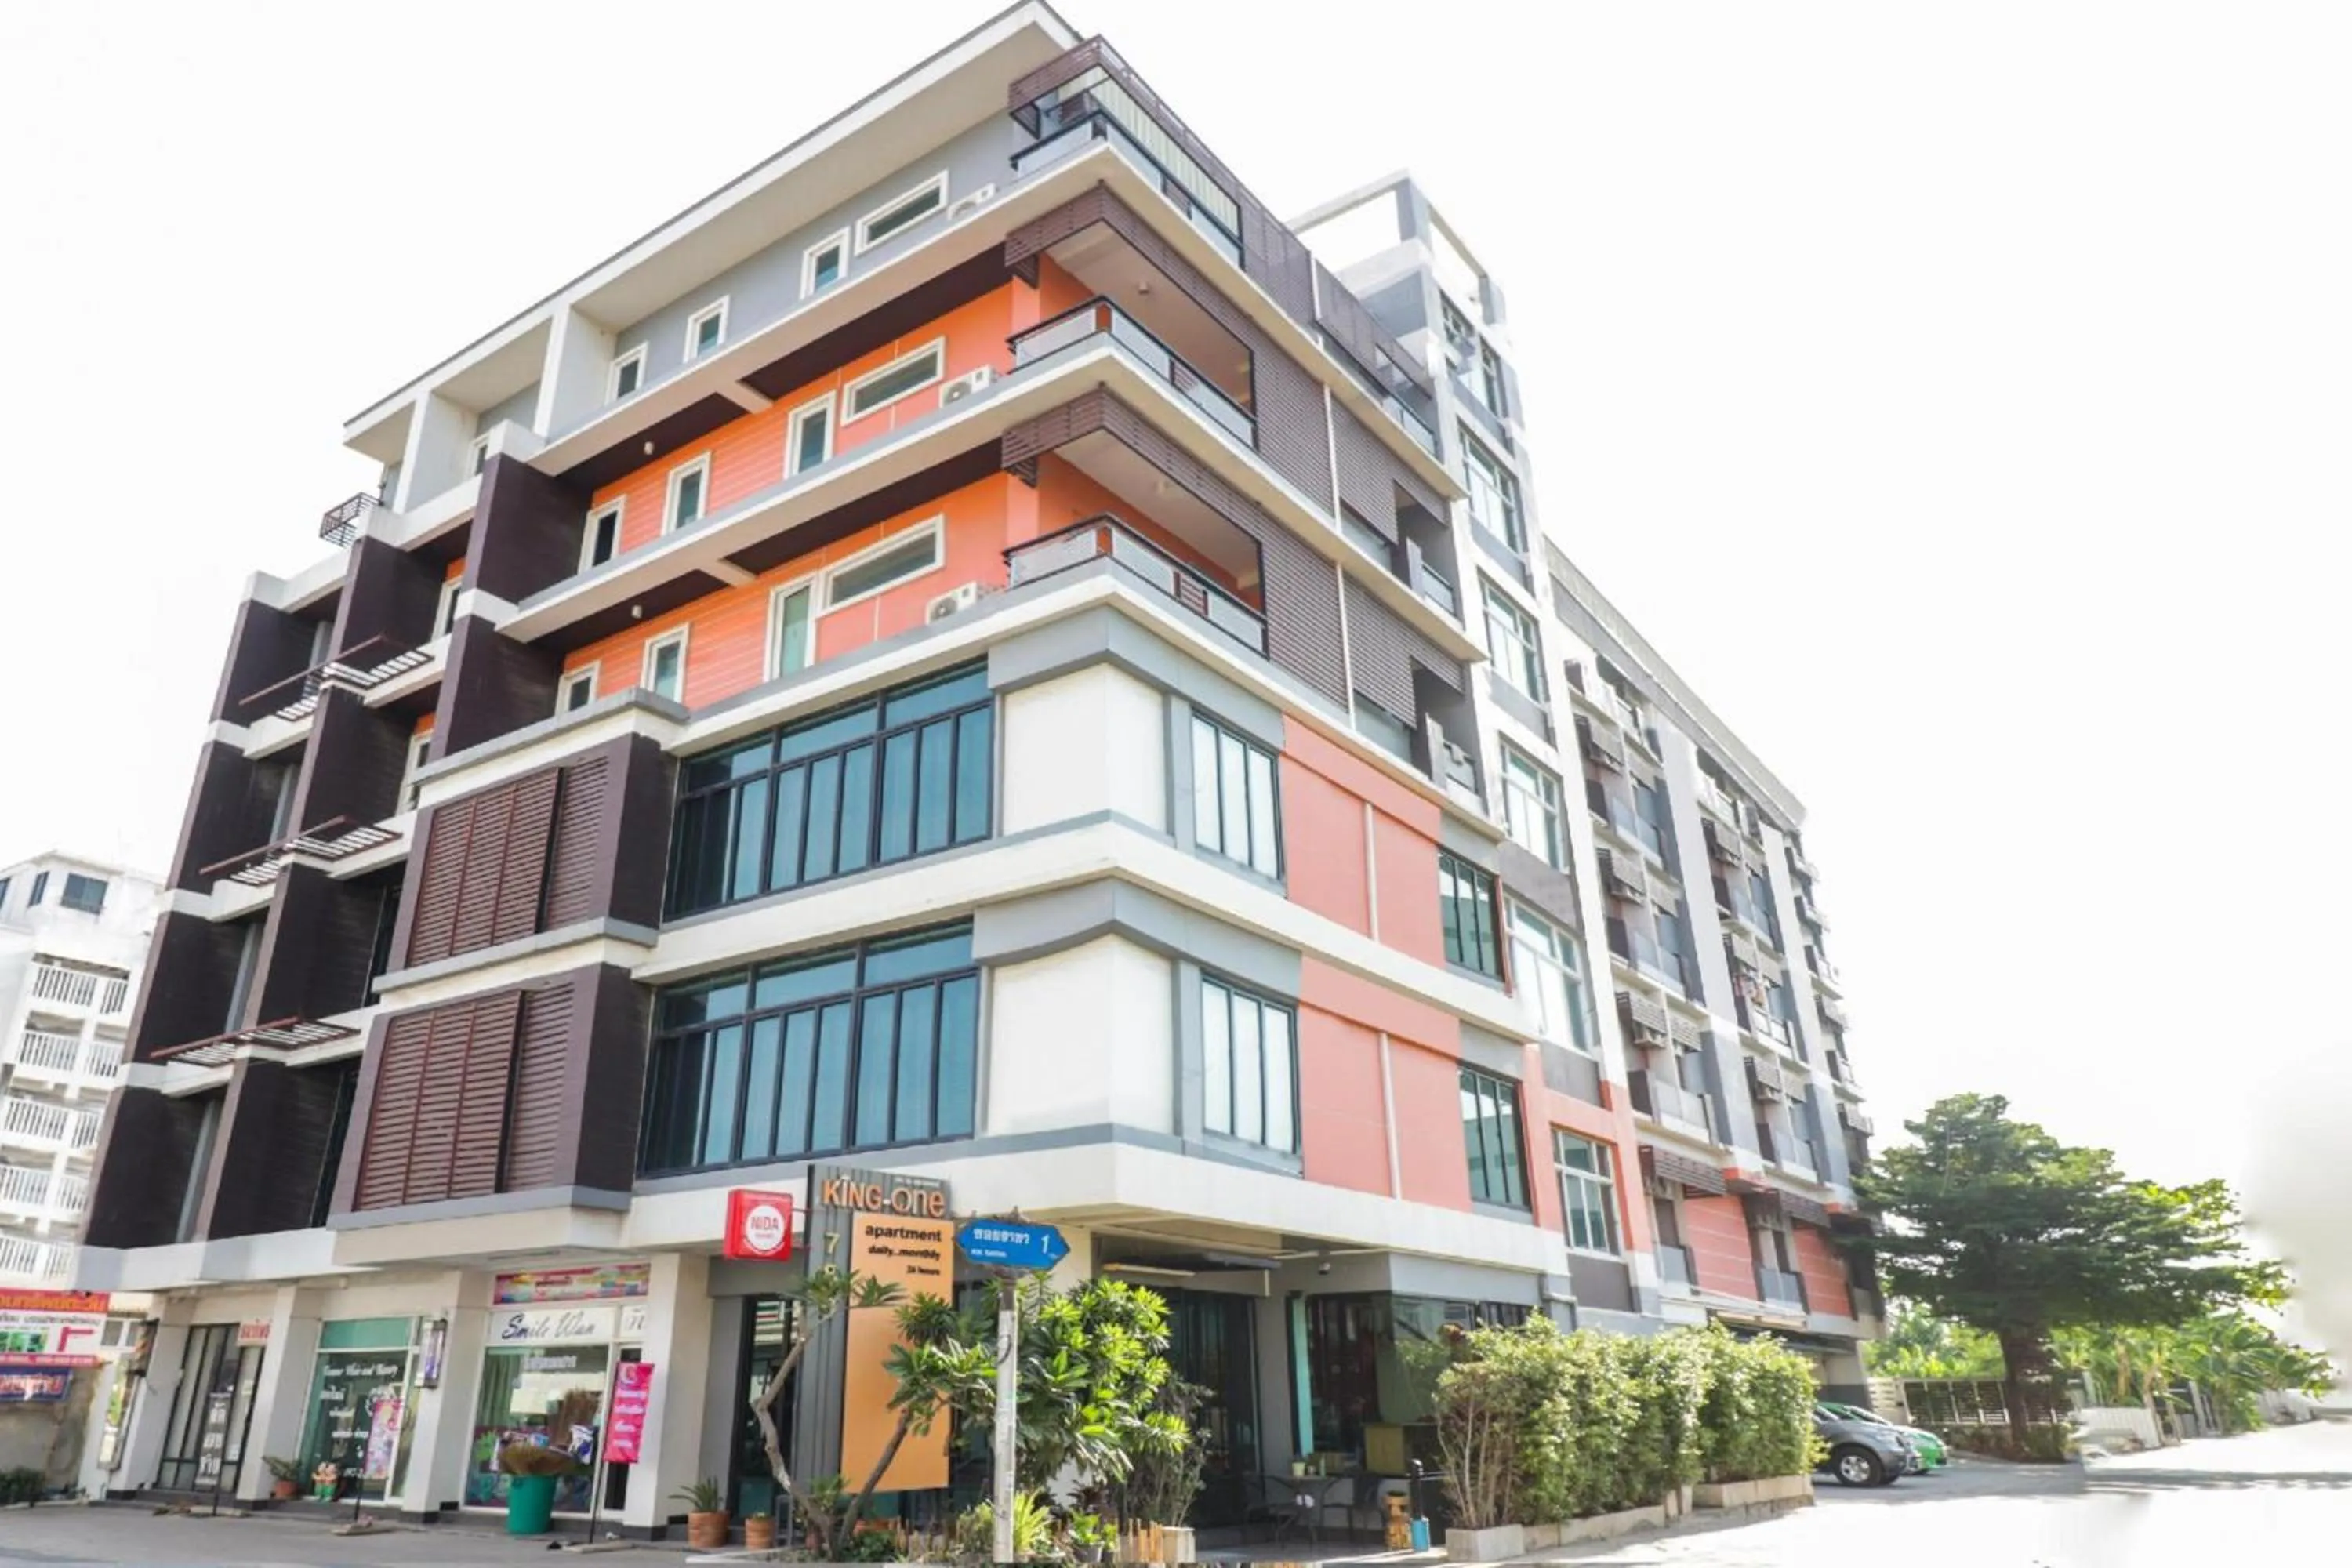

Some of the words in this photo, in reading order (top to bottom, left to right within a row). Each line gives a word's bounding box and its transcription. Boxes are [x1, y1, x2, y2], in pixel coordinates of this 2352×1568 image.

[750, 1216, 779, 1230] NIDA
[865, 1225, 942, 1242] apartment
[1041, 1234, 1050, 1254] 1
[501, 1312, 550, 1340] Smile
